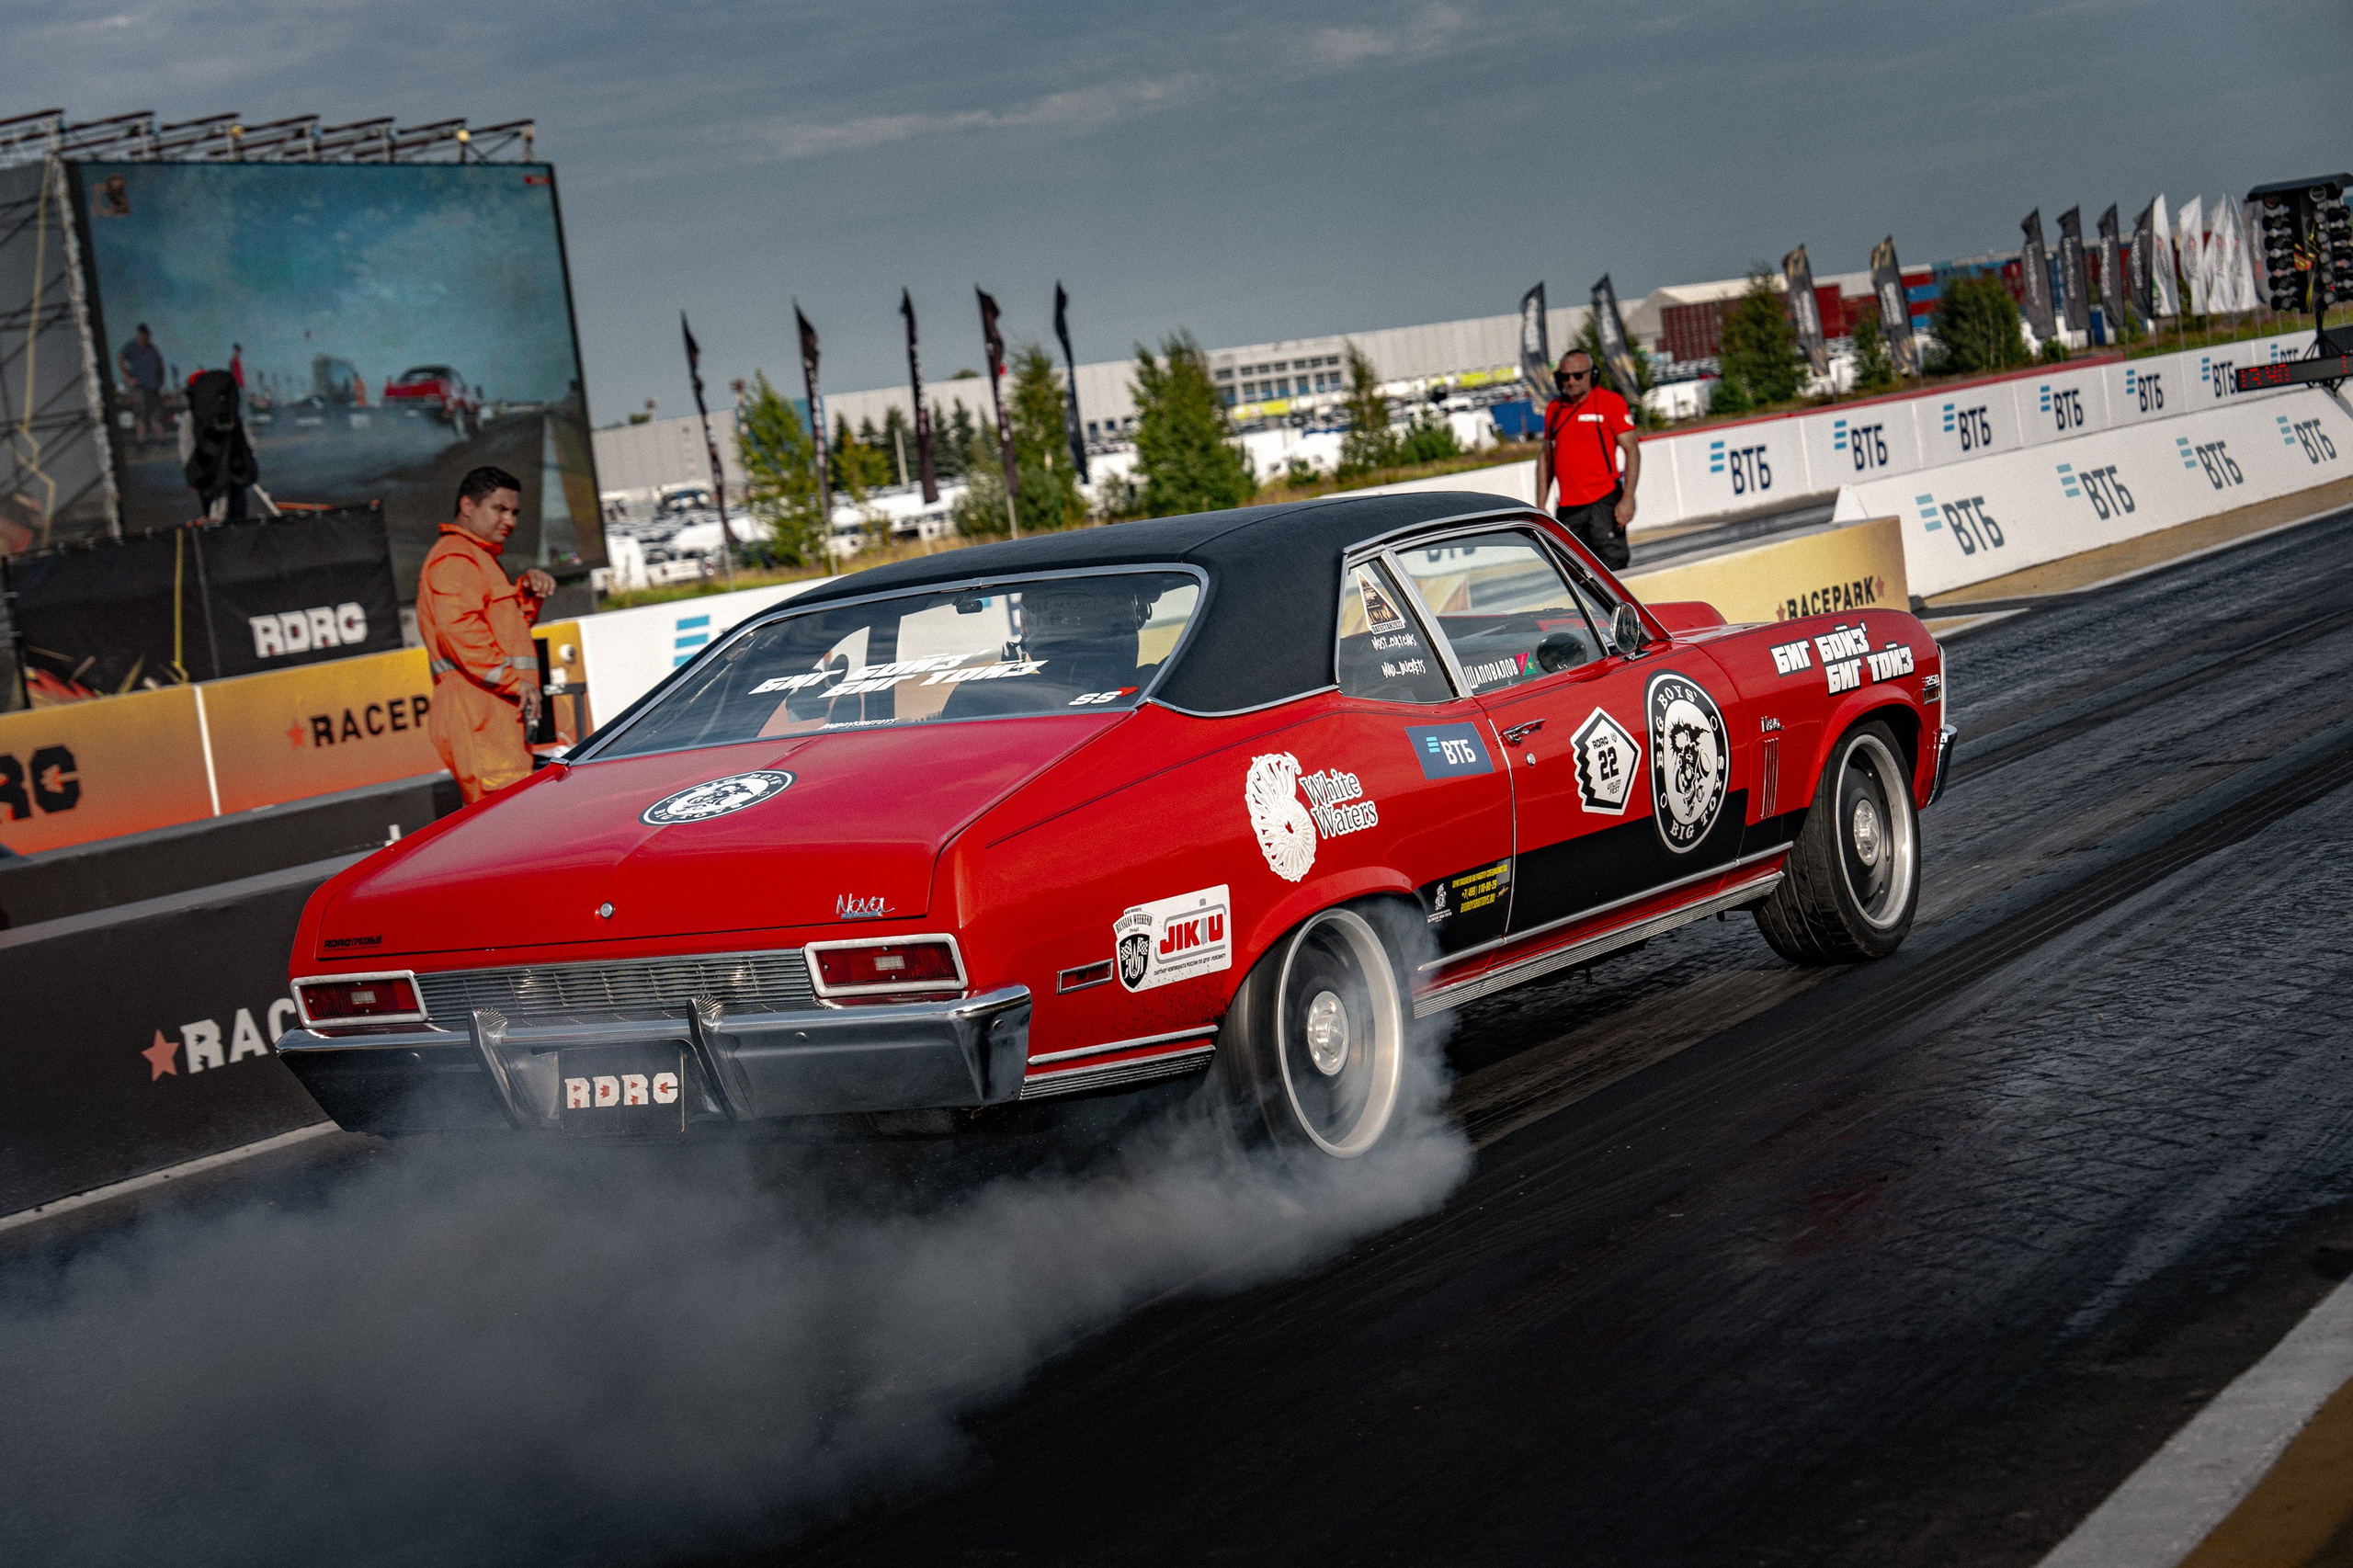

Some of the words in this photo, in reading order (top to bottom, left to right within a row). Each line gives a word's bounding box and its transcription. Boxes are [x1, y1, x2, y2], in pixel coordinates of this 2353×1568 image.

[2138, 373, 2164, 412] ВТБ
[2212, 361, 2236, 398] ВТБ
[1959, 406, 1992, 451] ВТБ
[2054, 389, 2084, 430] ВТБ
[1851, 424, 1888, 471] ВТБ
[2294, 419, 2337, 465] ВТБ
[1729, 446, 1771, 494] ВТБ
[2195, 441, 2244, 491] ВТБ
[2079, 465, 2136, 520] ВТБ
[1941, 496, 2005, 555] ВТБ
[1786, 576, 1876, 619] RACEPARK
[249, 602, 368, 658] RDRC
[1463, 657, 1519, 689] ШАПОВАЛОВ
[1769, 640, 1813, 675] БИГ
[1825, 658, 1862, 695] БИГ
[1866, 642, 1915, 682] ТОЙЗ
[748, 669, 845, 695] БИГ
[817, 674, 917, 699] БИГ
[919, 659, 1050, 687] ТОЙЗ
[1068, 690, 1123, 706] SS
[311, 694, 431, 747] RACEP
[1439, 739, 1476, 765] ВТБ
[1591, 735, 1609, 750] RDRC
[1656, 714, 1665, 768] BIG
[1597, 746, 1620, 781] 22
[1301, 770, 1361, 806] White
[1669, 819, 1695, 840] BIG
[1701, 755, 1725, 827] TOYS
[654, 808, 674, 821] BIG
[1313, 802, 1377, 836] Waters
[835, 892, 896, 915] Nova
[1133, 914, 1154, 926] WEEKEND
[564, 1072, 678, 1109] RDRC
